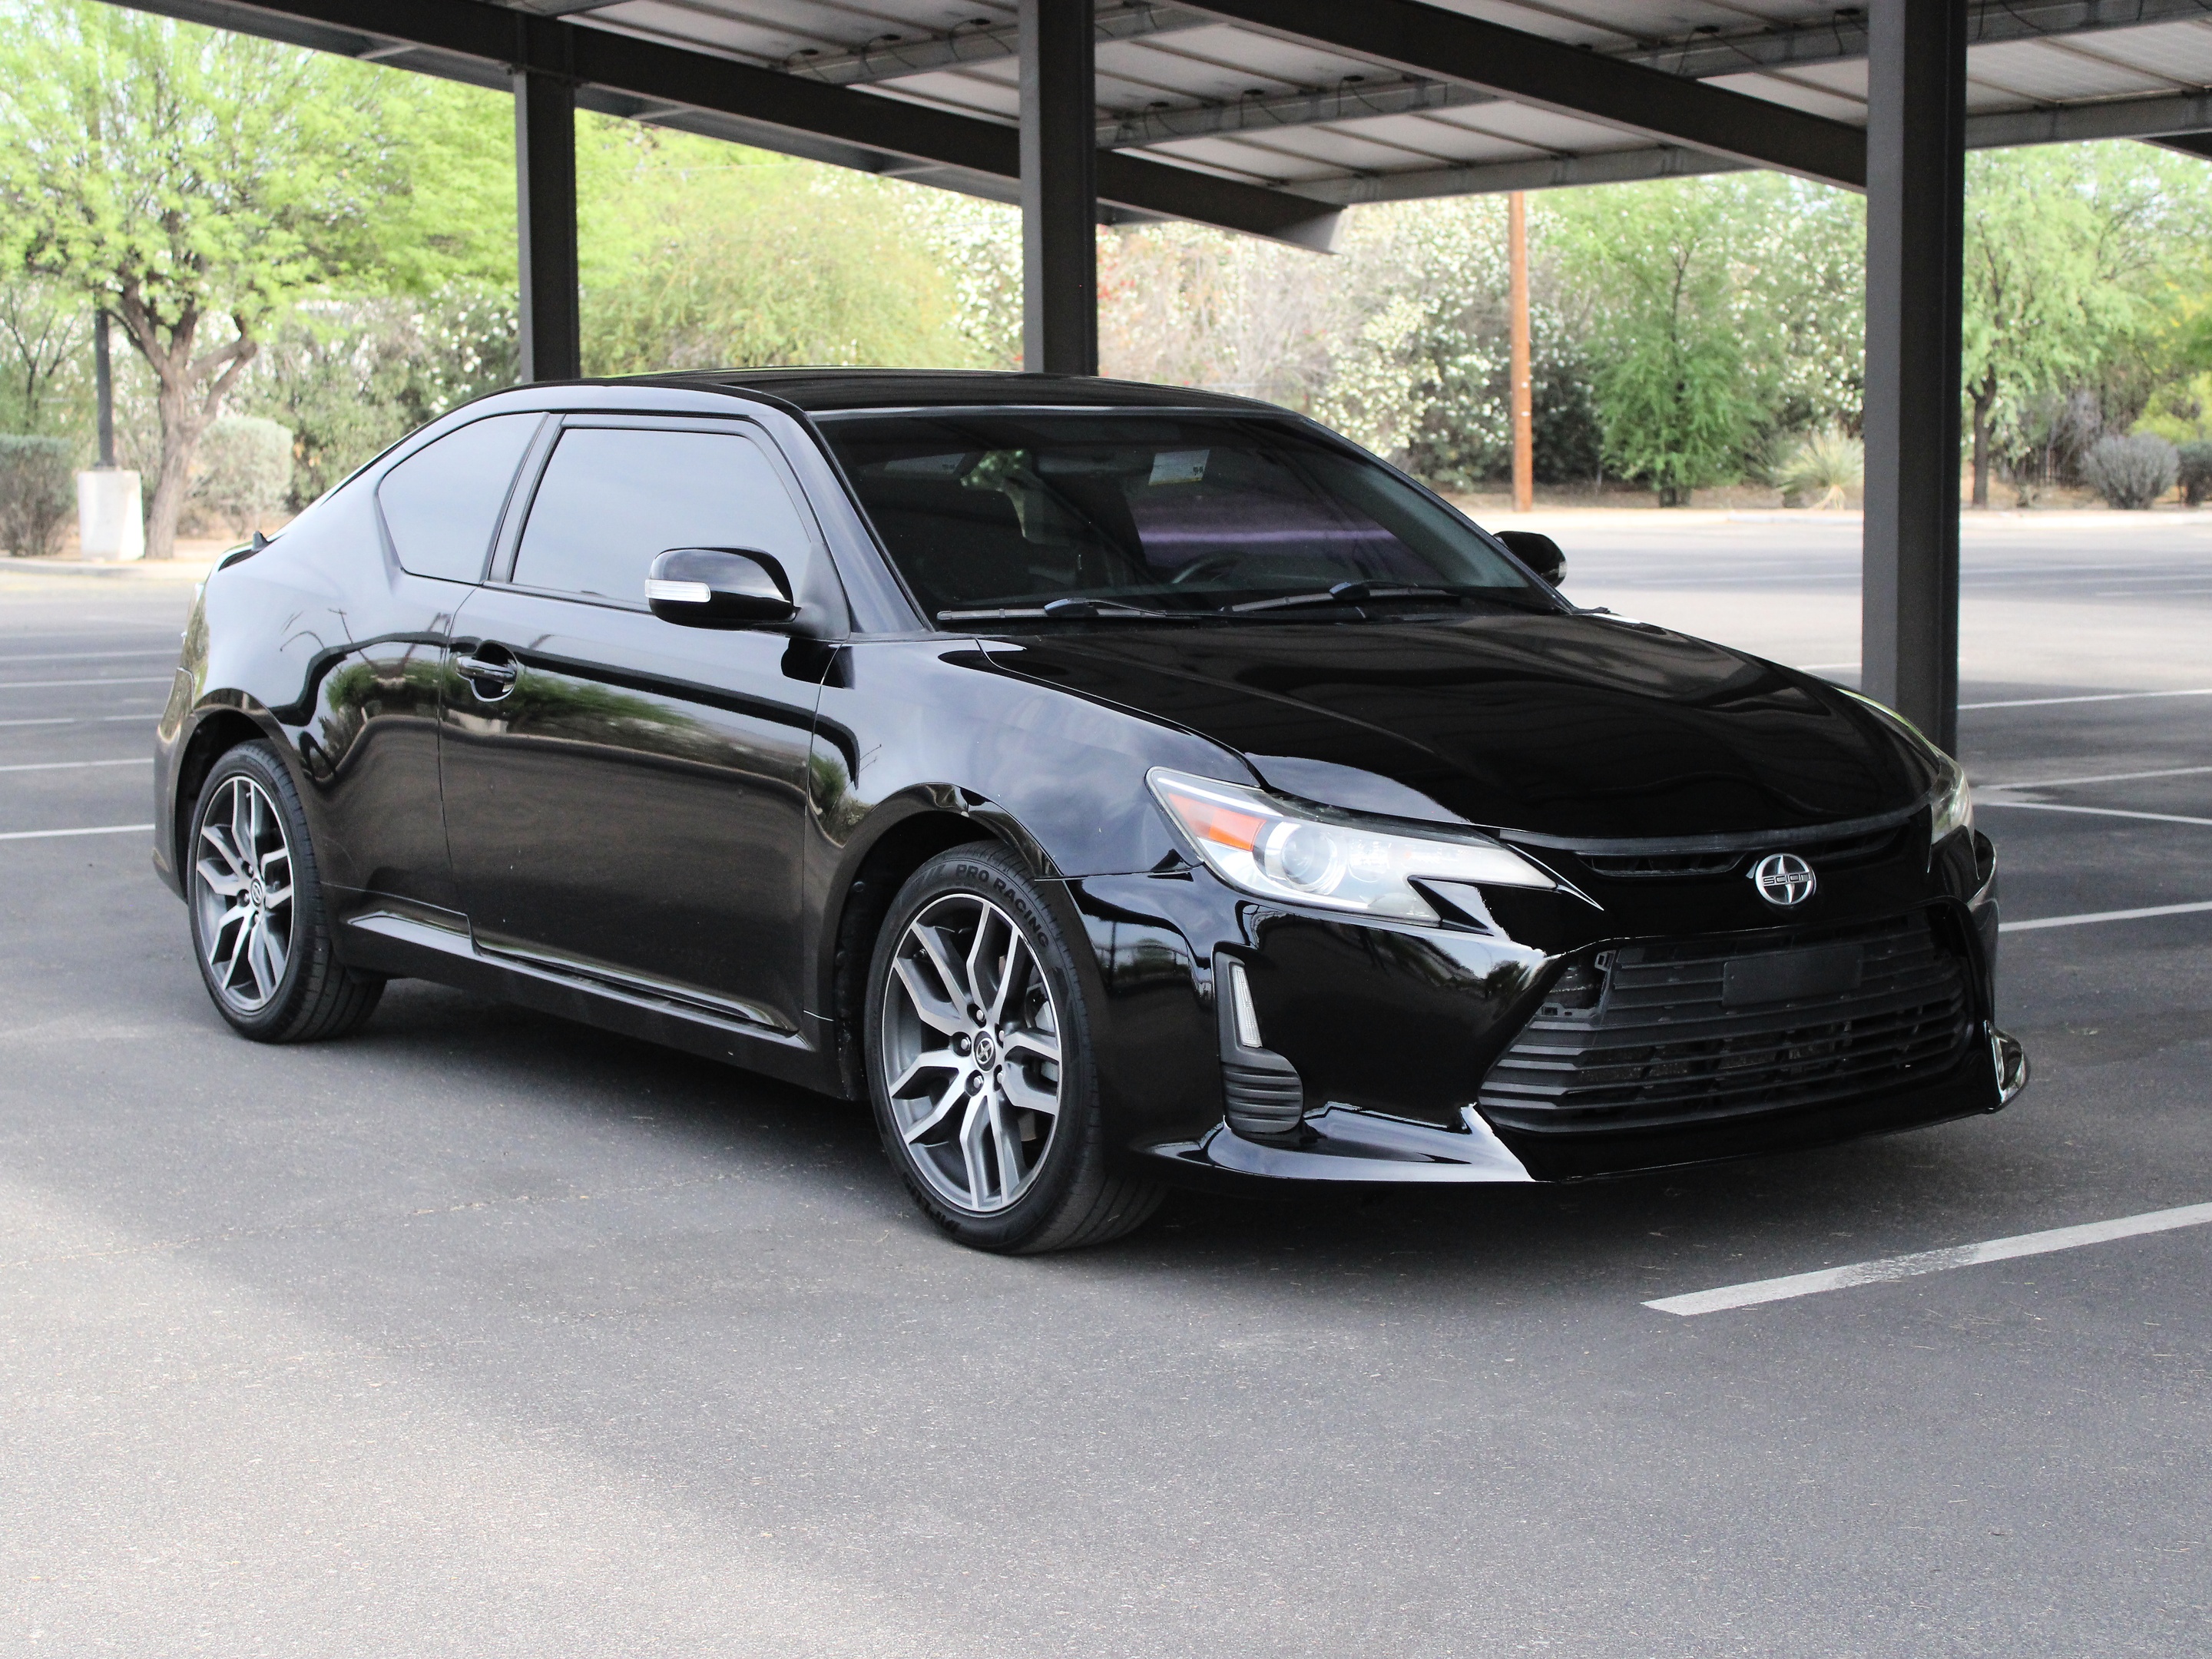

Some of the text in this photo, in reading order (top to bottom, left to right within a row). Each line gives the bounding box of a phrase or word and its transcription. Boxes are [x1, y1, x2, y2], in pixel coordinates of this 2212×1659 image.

[1763, 873, 1810, 886] SCION
[955, 863, 1049, 947] PRO RACING
